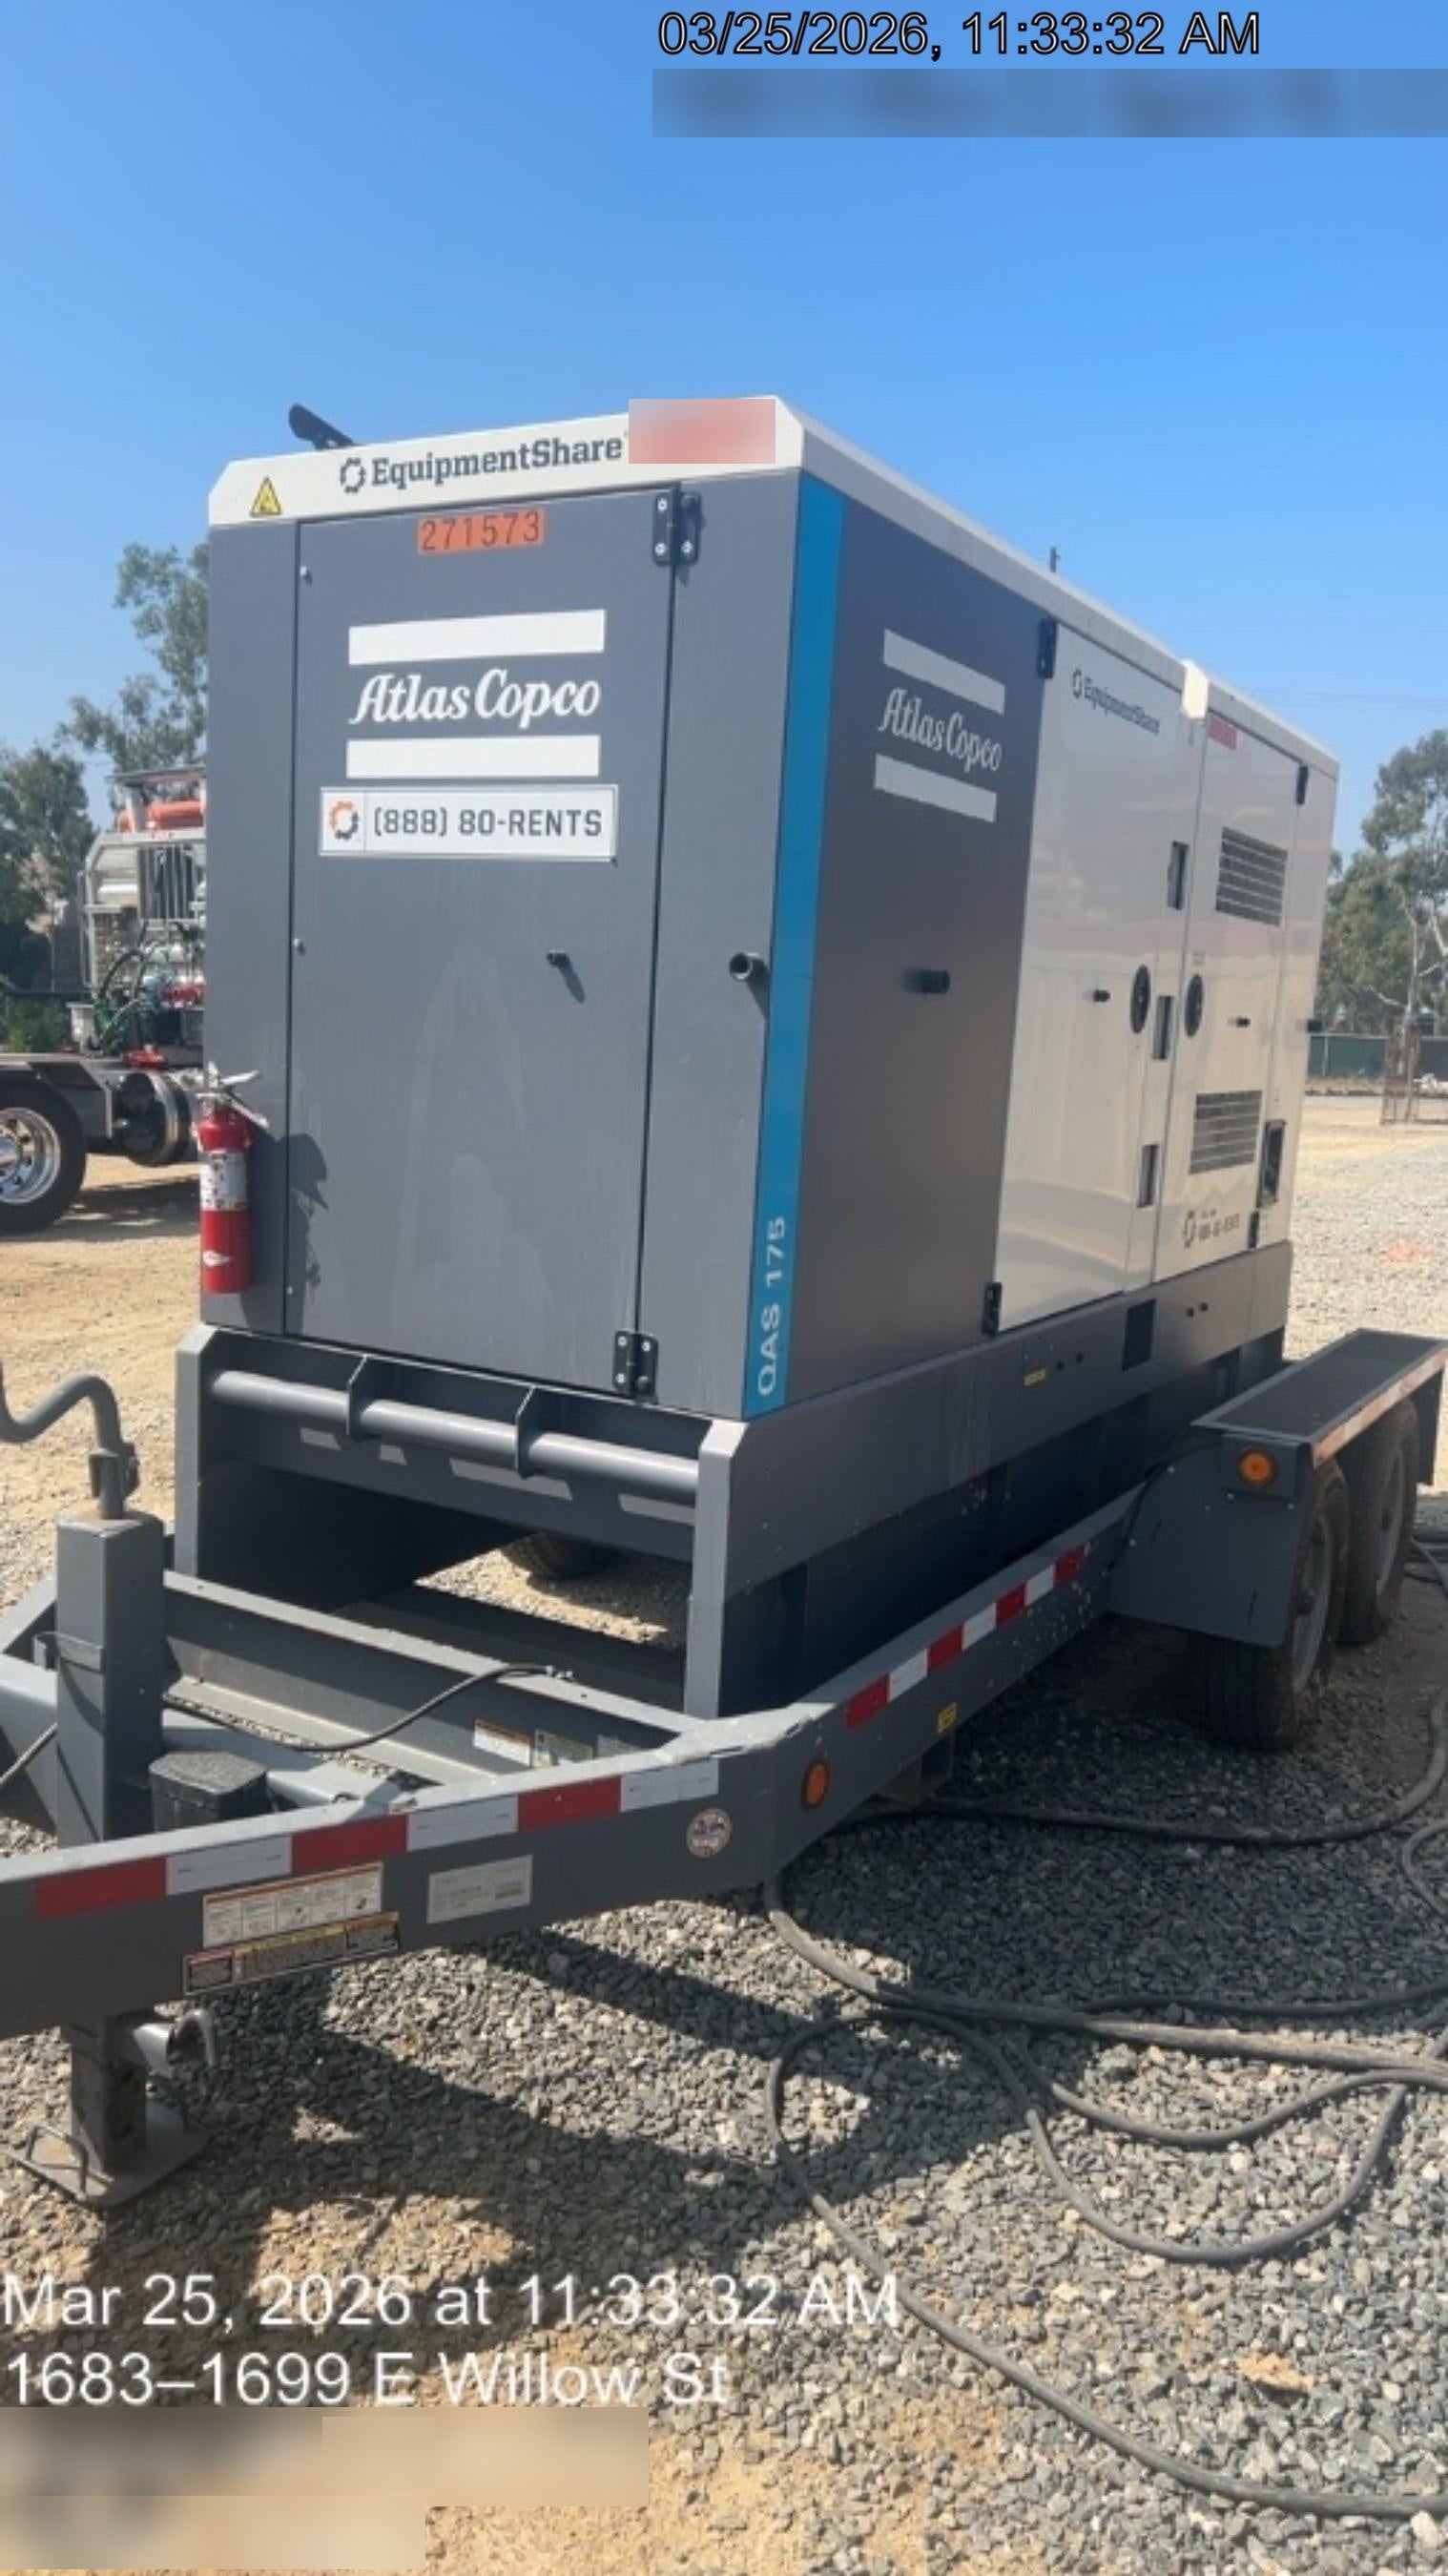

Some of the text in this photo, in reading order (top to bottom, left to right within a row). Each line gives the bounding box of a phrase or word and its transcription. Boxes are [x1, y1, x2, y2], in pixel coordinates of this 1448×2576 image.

[372, 437, 623, 489] EquipmentShare
[422, 510, 540, 551] 271573
[374, 807, 603, 838] (888) 80-RENTS
[757, 1215, 786, 1396] QAS 175
